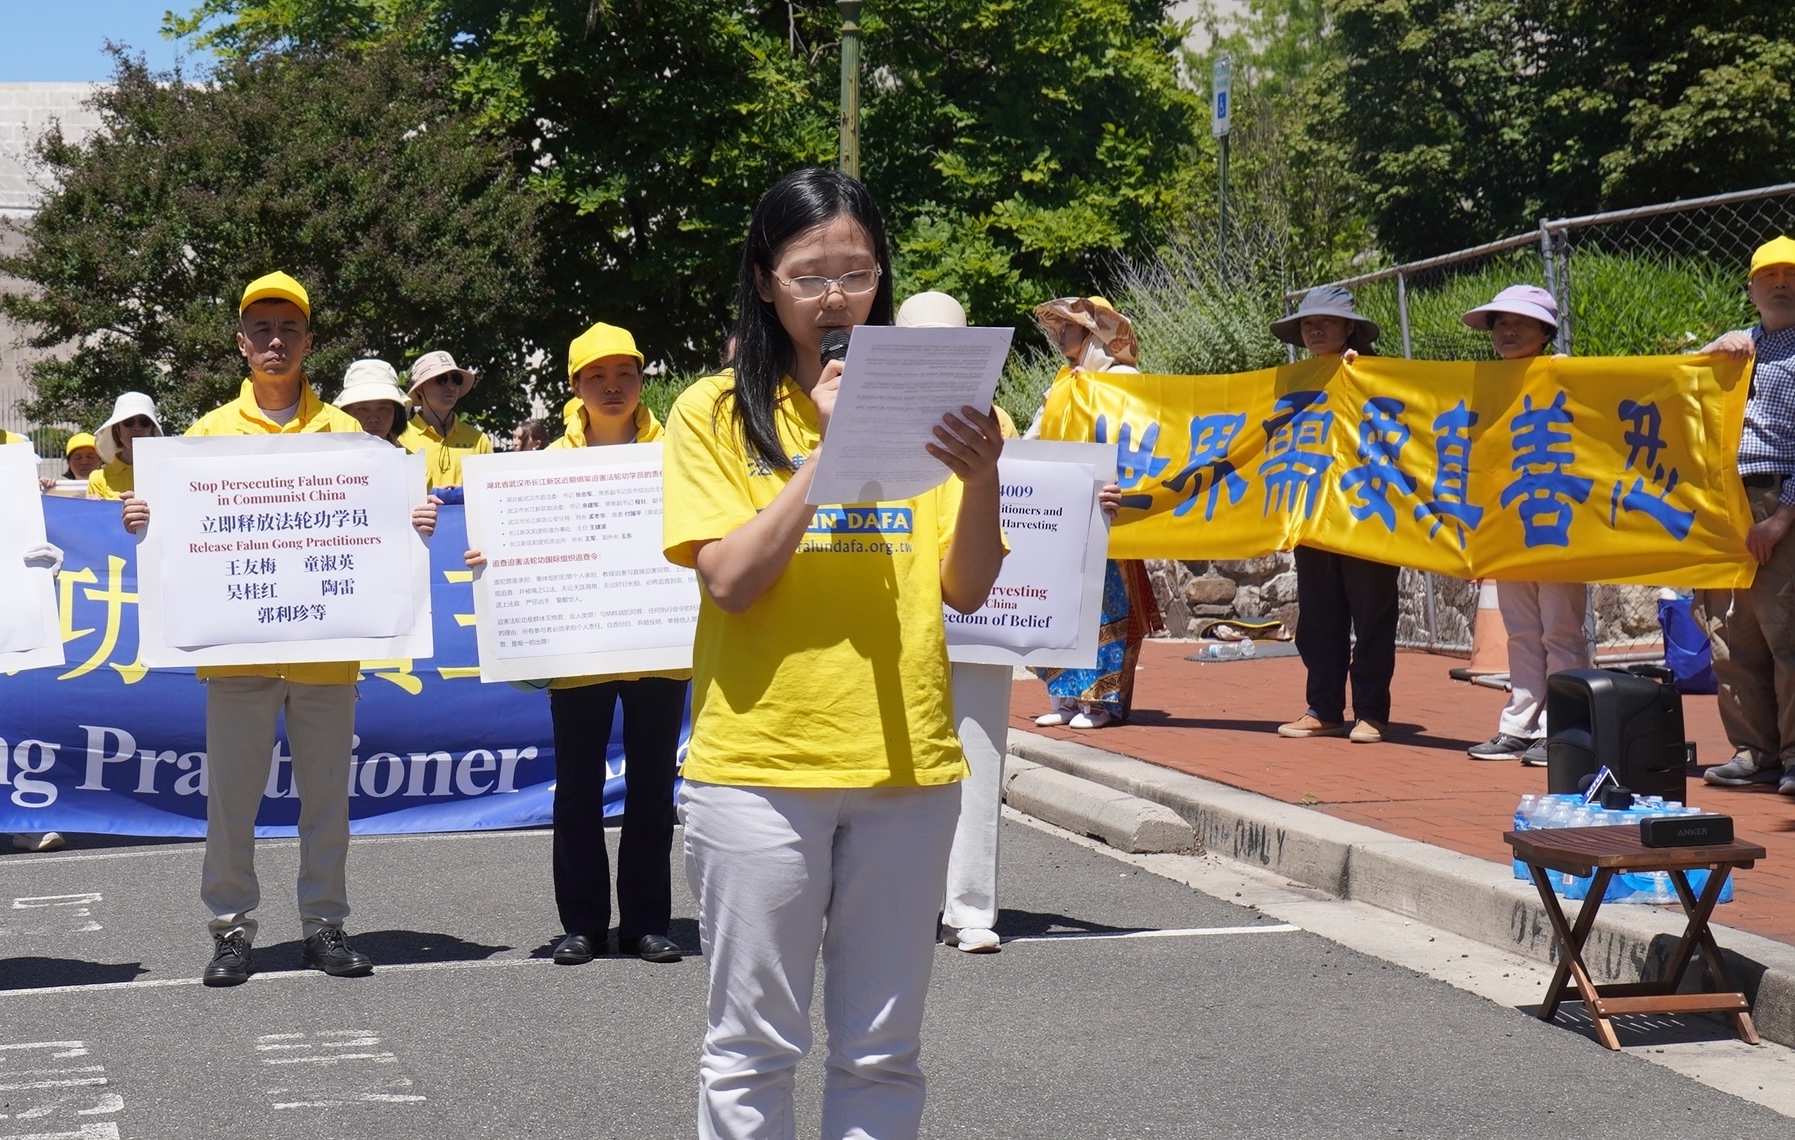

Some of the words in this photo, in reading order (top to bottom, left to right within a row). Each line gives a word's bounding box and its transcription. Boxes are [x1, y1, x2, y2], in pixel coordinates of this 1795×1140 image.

[189, 480, 218, 493] Stop
[221, 476, 295, 490] Persecuting
[298, 474, 333, 487] Falun
[336, 473, 369, 486] Gong
[217, 494, 230, 506] in
[233, 490, 306, 505] Communist
[309, 489, 346, 501] China
[1001, 503, 1041, 516] itioners
[1043, 507, 1063, 517] and
[199, 508, 369, 534] 立即释放法轮功学员
[847, 512, 910, 529] DAFA
[1001, 518, 1058, 532] Harvesting
[189, 540, 233, 553] Release
[236, 539, 269, 552] Falun
[272, 538, 303, 551] Gong
[306, 534, 382, 548] Practitioners
[225, 557, 277, 576] 王友梅
[303, 553, 355, 573] 童淑英
[226, 582, 279, 601] 吴桂红
[321, 577, 355, 596] 陶雷
[989, 585, 1048, 600] rvesting
[985, 598, 1018, 610] China
[257, 603, 327, 624] 郭利珍等
[943, 612, 988, 626] eedom
[992, 613, 1007, 626] of
[1010, 613, 1053, 629] Belief
[1677, 828, 1708, 837] ANKER
